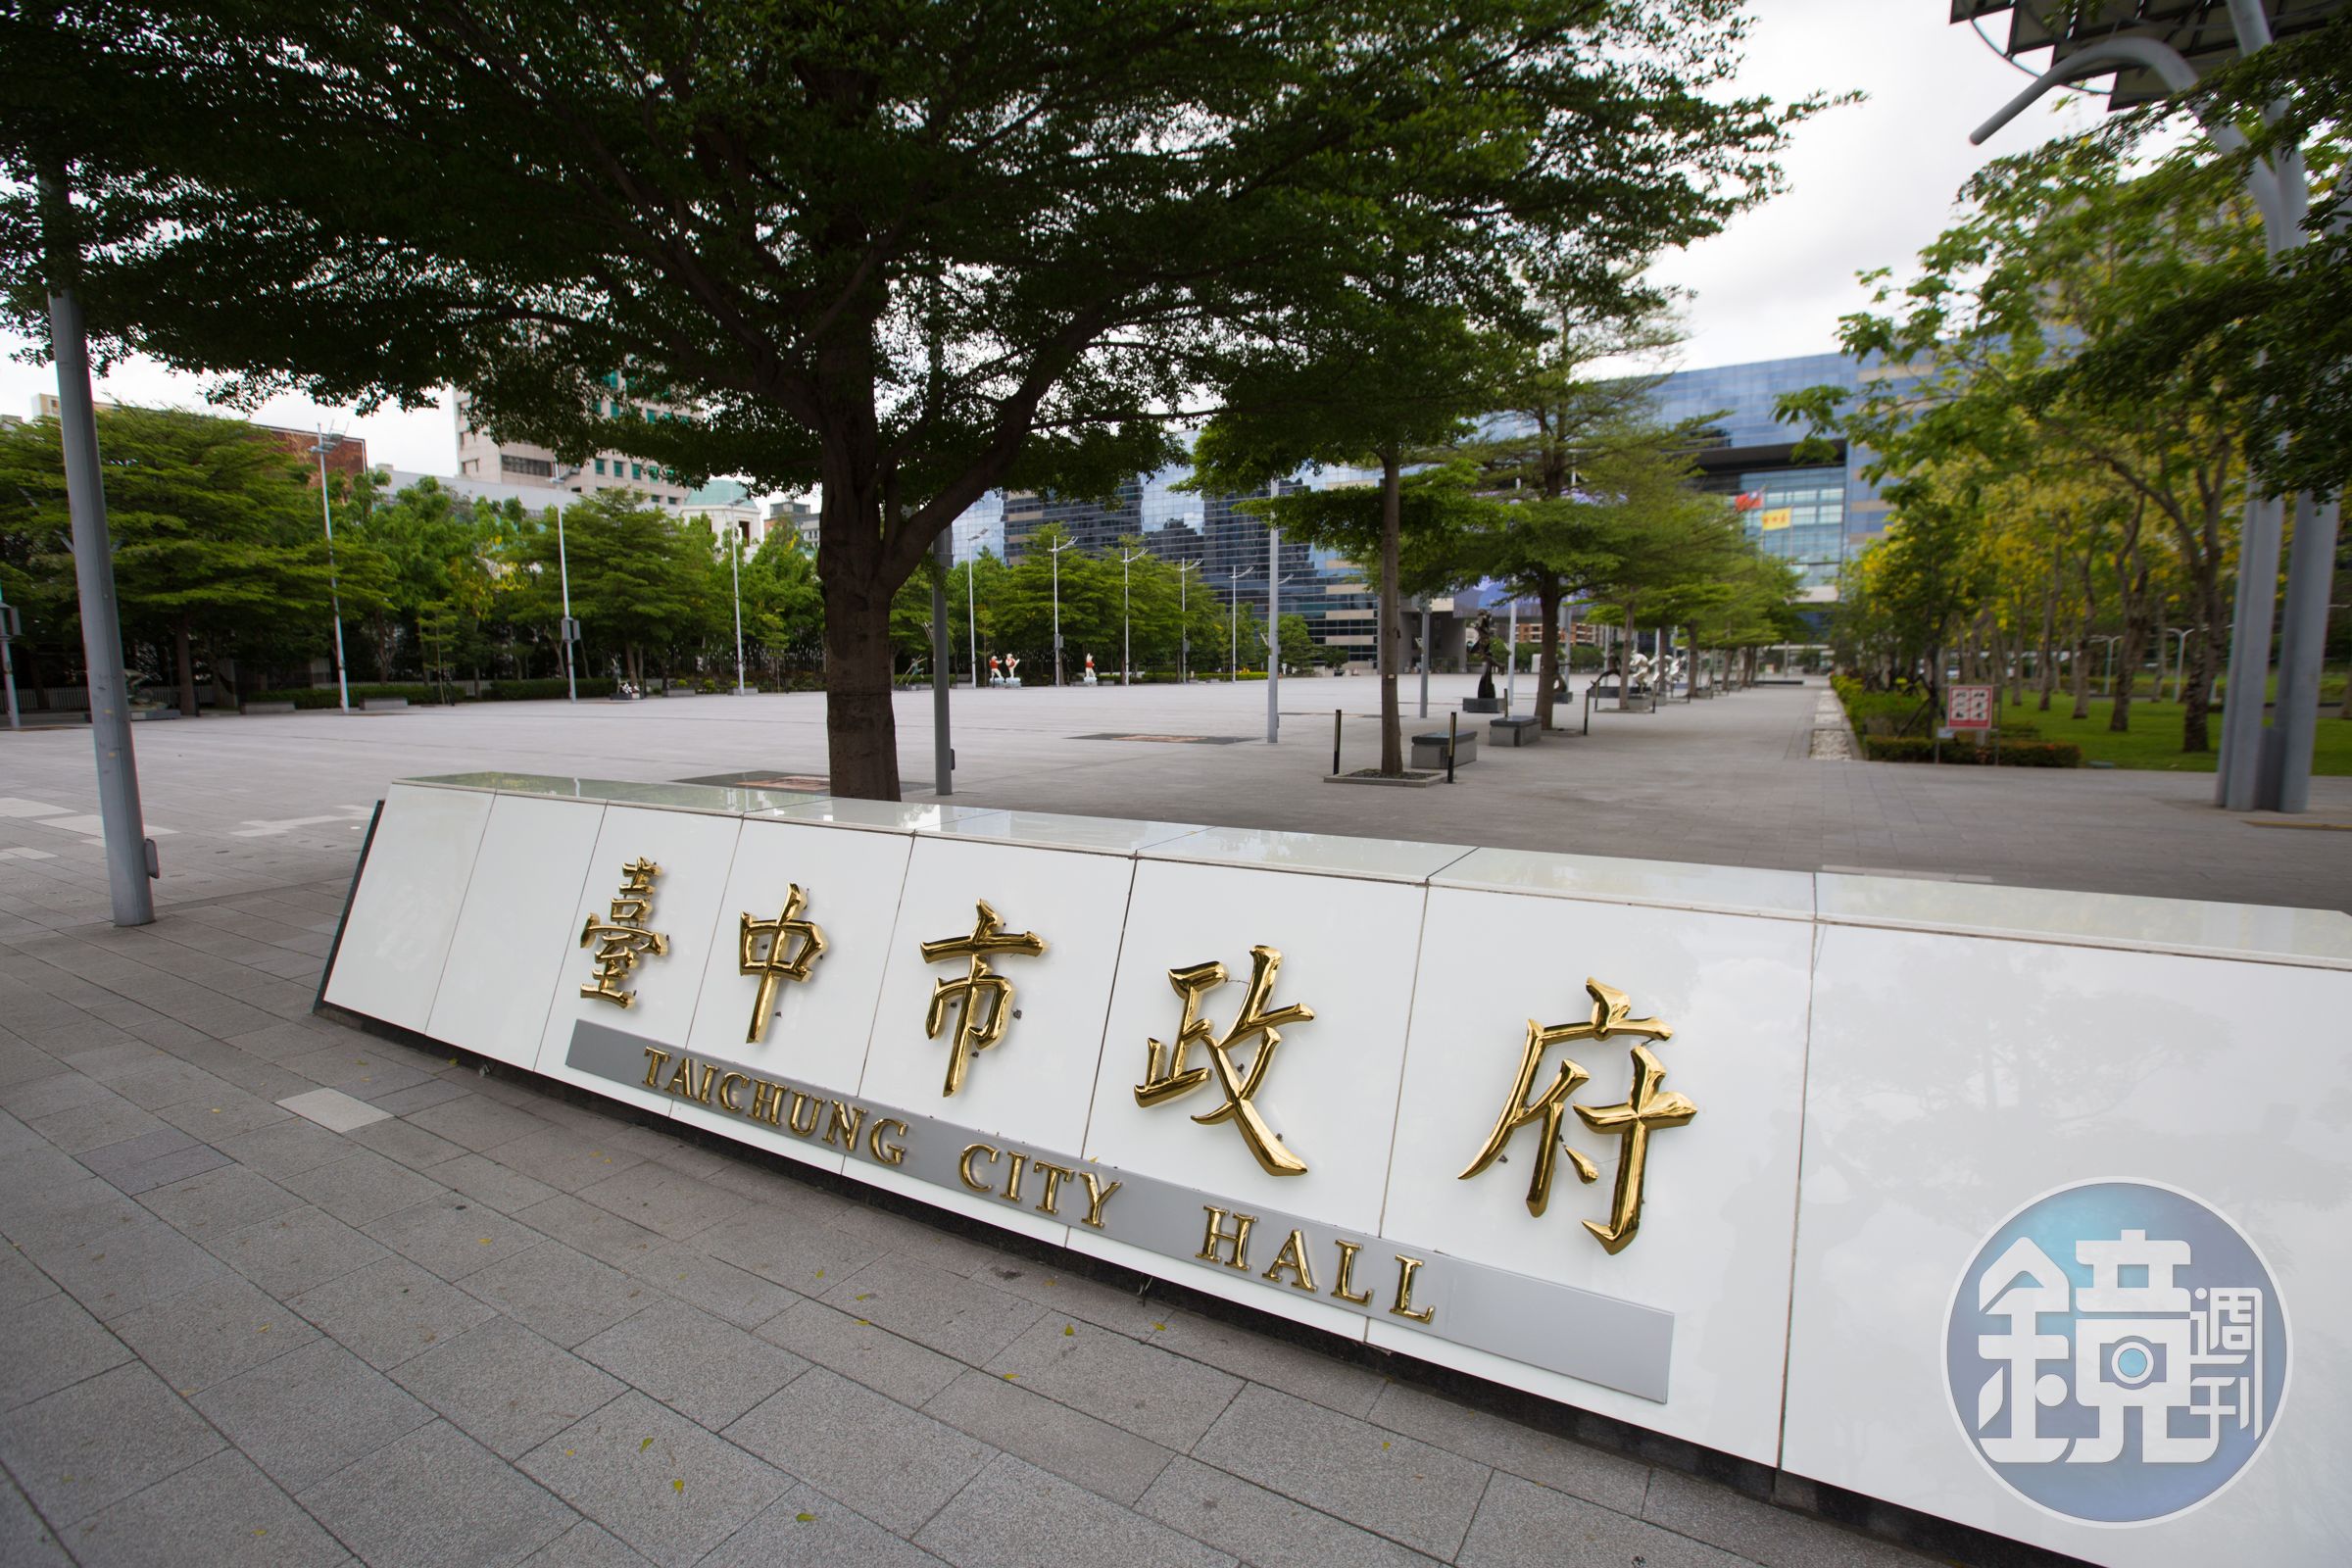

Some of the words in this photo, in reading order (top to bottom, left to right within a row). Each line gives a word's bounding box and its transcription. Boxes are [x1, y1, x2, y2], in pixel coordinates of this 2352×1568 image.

[580, 856, 1697, 1255] 臺中市政府
[642, 1046, 908, 1166] TAICHUNG
[958, 1143, 1121, 1229] CITY
[1195, 1204, 1434, 1324] HALL
